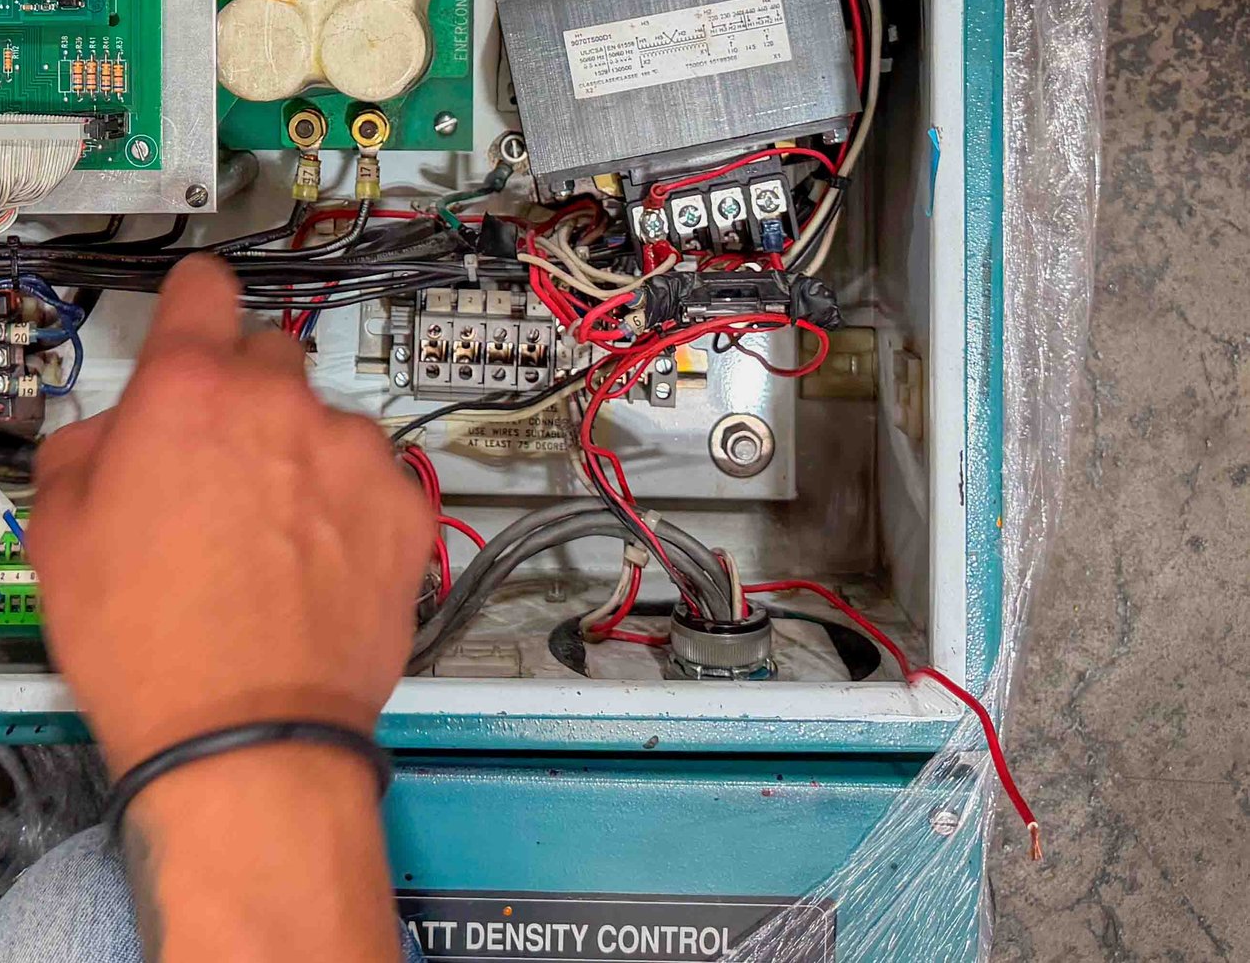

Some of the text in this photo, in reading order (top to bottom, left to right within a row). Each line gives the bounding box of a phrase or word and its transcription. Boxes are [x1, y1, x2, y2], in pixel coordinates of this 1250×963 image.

[360, 166, 372, 178] 17
[14, 332, 28, 344] 20
[468, 426, 486, 436] USE
[492, 427, 519, 437] WIRES
[468, 439, 479, 447] AT
[485, 439, 511, 449] LEAST
[517, 440, 529, 449] 75
[0, 572, 5, 580] 2
[407, 920, 734, 956] ATT DENSITY CONTROL
